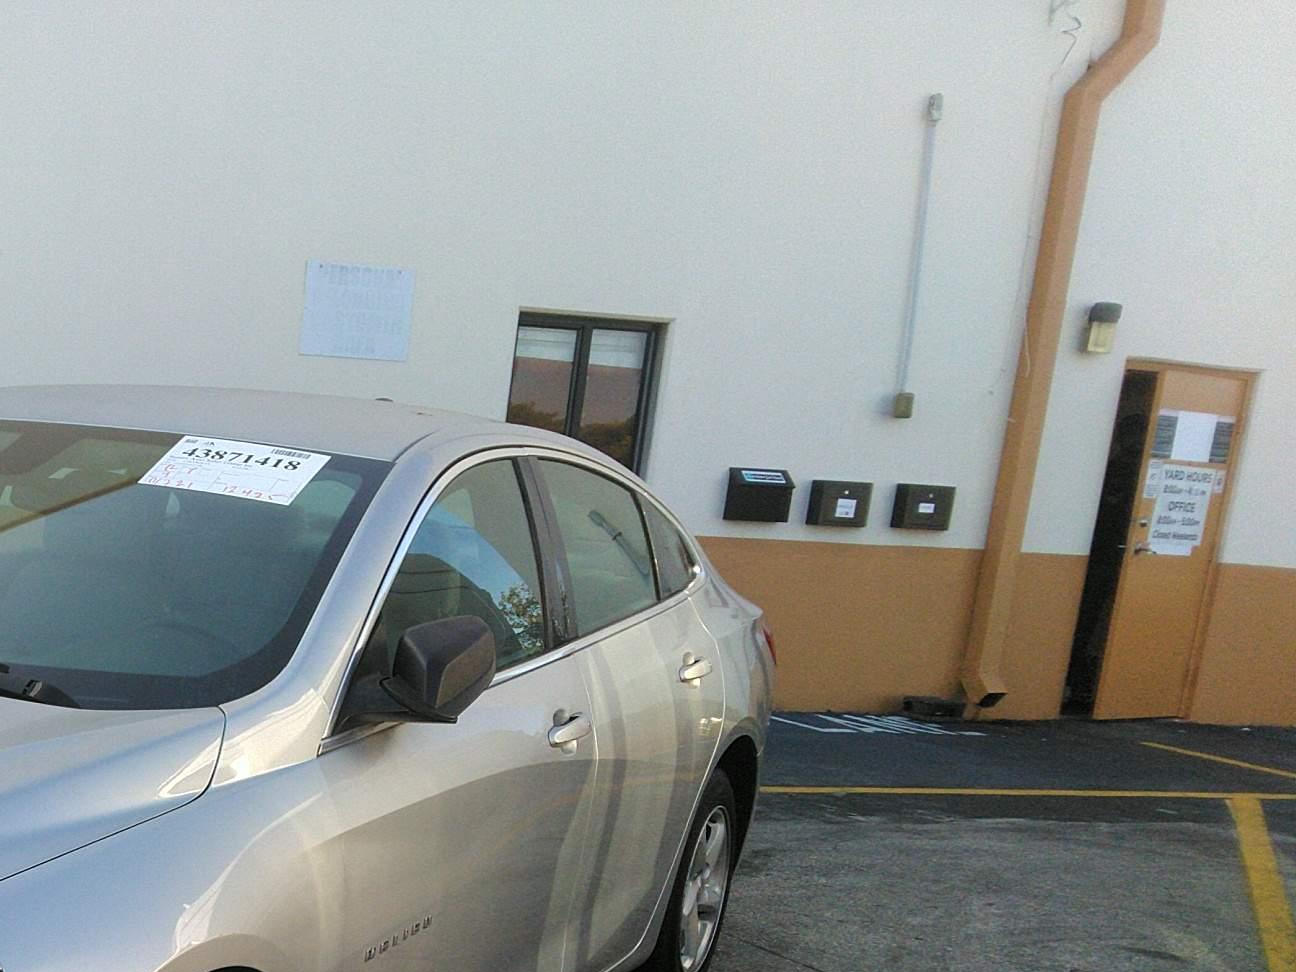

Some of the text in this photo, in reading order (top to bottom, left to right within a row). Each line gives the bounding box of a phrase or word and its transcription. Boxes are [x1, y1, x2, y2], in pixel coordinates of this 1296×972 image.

[182, 448, 302, 470] 43871418
[1165, 469, 1185, 481] YARD
[1168, 501, 1197, 513] OFFICE
